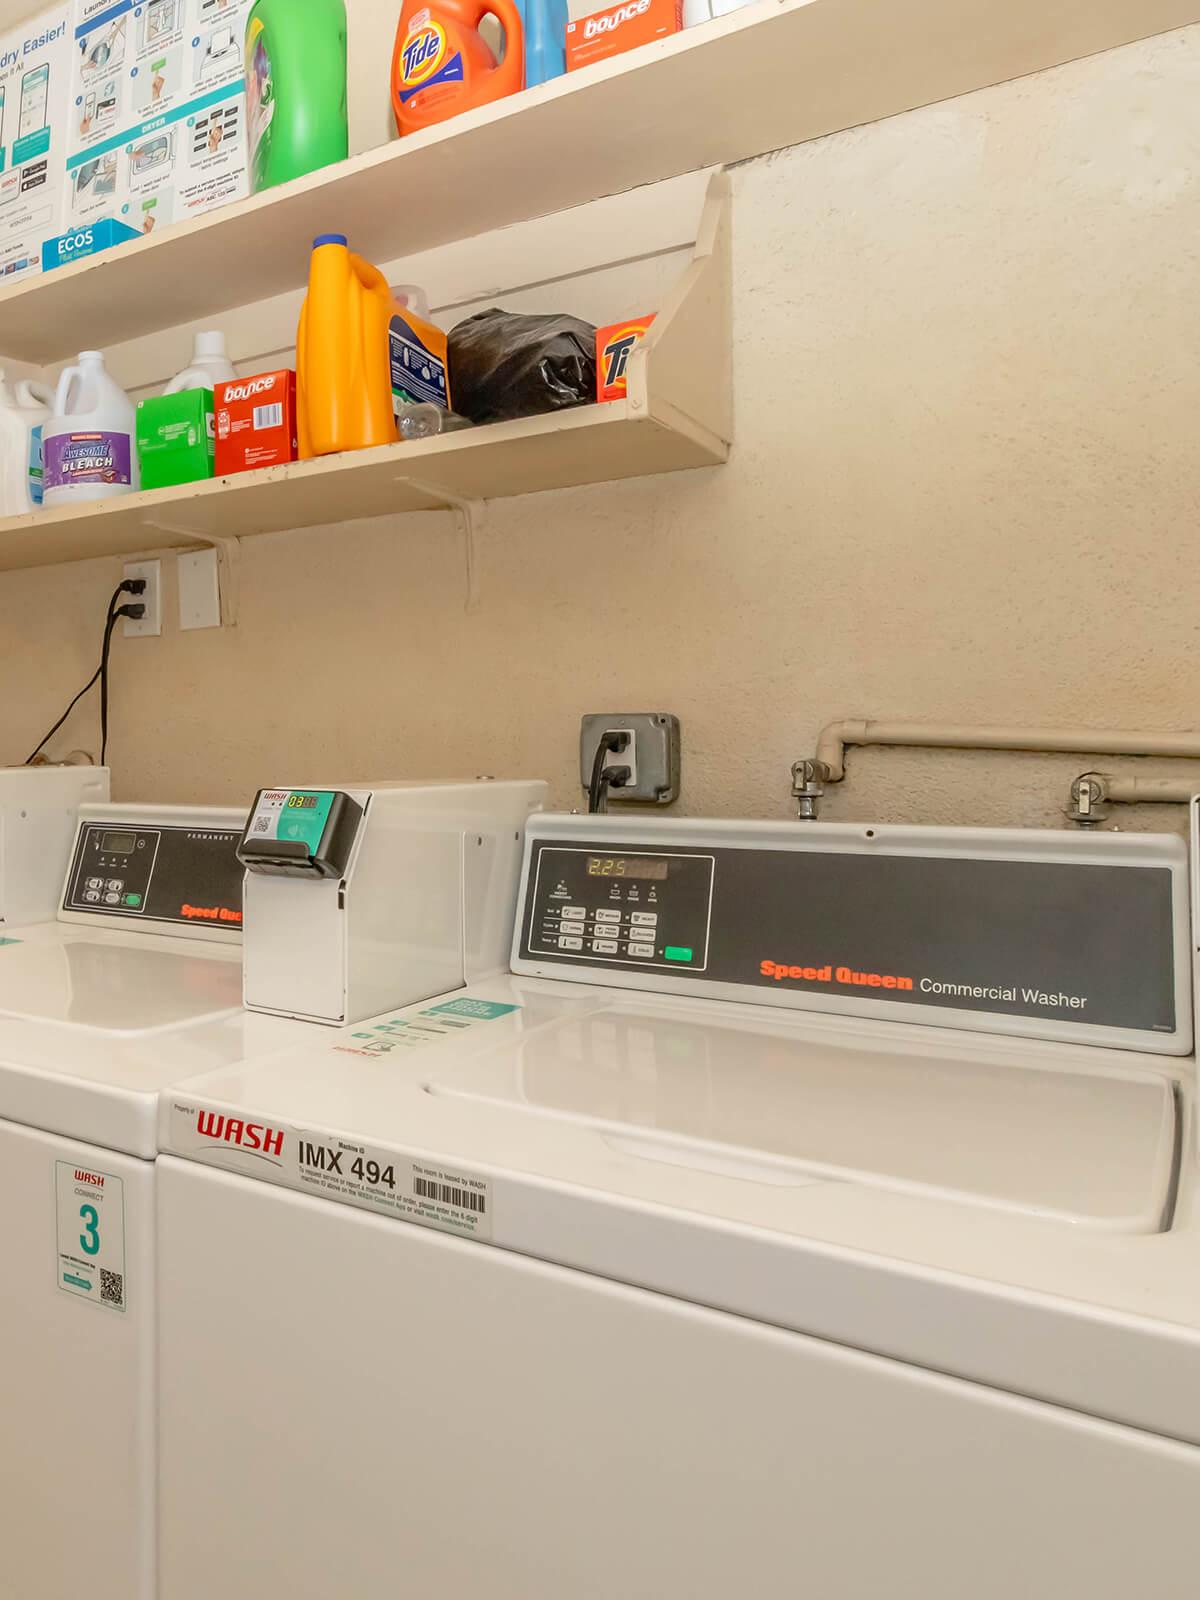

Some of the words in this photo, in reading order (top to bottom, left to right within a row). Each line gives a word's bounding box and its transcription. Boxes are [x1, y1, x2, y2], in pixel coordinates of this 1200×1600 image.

[584, 0, 649, 38] bounce
[23, 21, 66, 55] Easier!
[402, 31, 440, 81] Tide
[57, 230, 94, 254] ECOS
[604, 334, 637, 387] Ti
[224, 376, 276, 403] bounce
[62, 457, 113, 473] BLEACH
[63, 444, 108, 459] AWESOME
[264, 792, 288, 801] WASH
[187, 833, 235, 842] PERMANENT
[181, 904, 218, 919] Speed
[219, 908, 243, 921] Que
[760, 959, 832, 983] Speed
[835, 966, 913, 991] Queen
[919, 978, 1017, 1001] Commercial
[1020, 988, 1088, 1009] Washer
[197, 1110, 284, 1156] WASH
[74, 1169, 105, 1187] WASH
[299, 1140, 343, 1175] IMX
[350, 1156, 396, 1190] 494
[412, 1163, 423, 1173] This
[461, 1178, 468, 1187] by
[469, 1180, 487, 1190] WASH
[74, 1187, 104, 1201] CONNECT
[80, 1204, 100, 1256] 3
